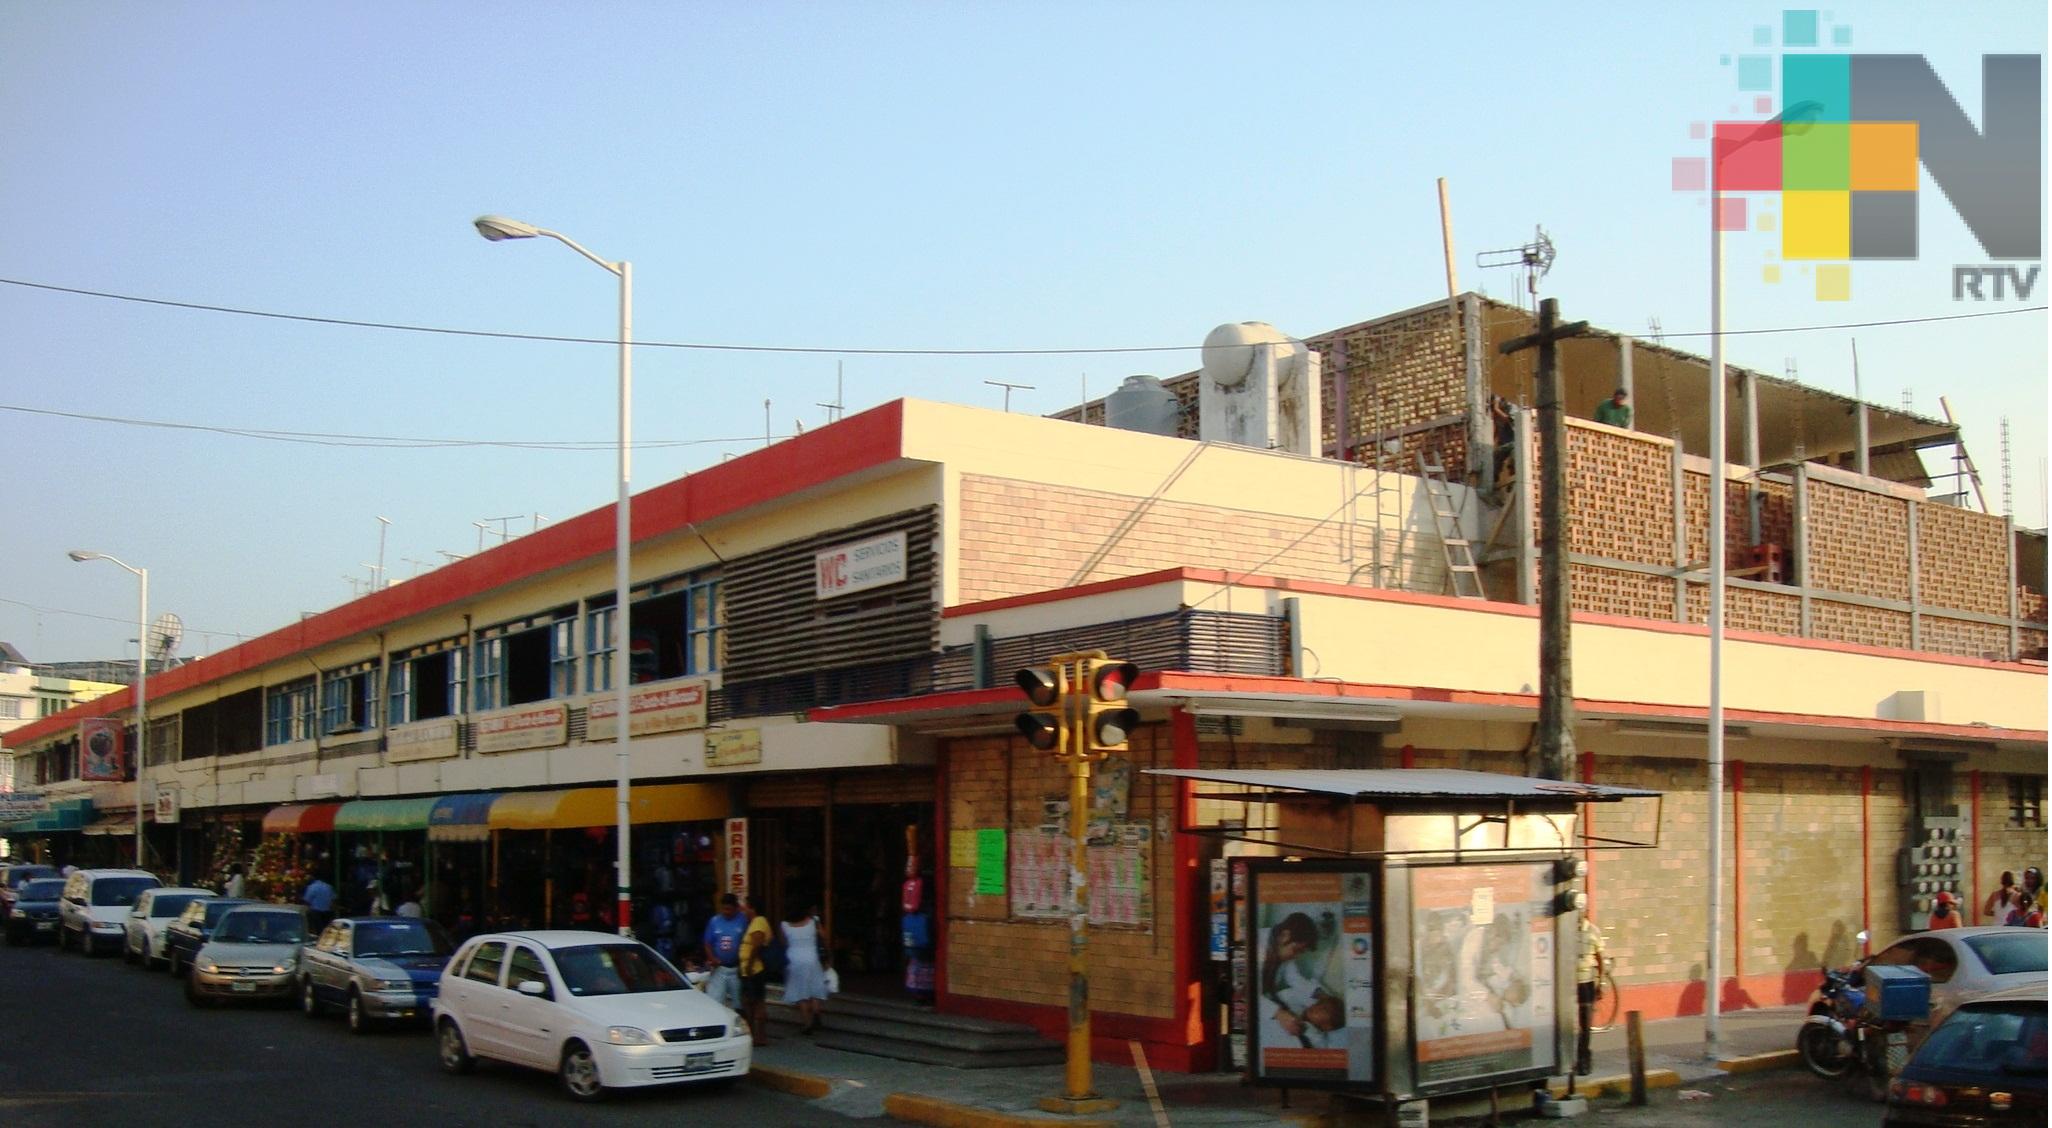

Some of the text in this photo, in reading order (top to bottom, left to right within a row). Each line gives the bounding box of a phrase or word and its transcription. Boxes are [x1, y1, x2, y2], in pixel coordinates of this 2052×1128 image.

[854, 539, 899, 562] SERVICIOS
[820, 553, 848, 590] WC
[852, 561, 901, 584] SANITARIOS
